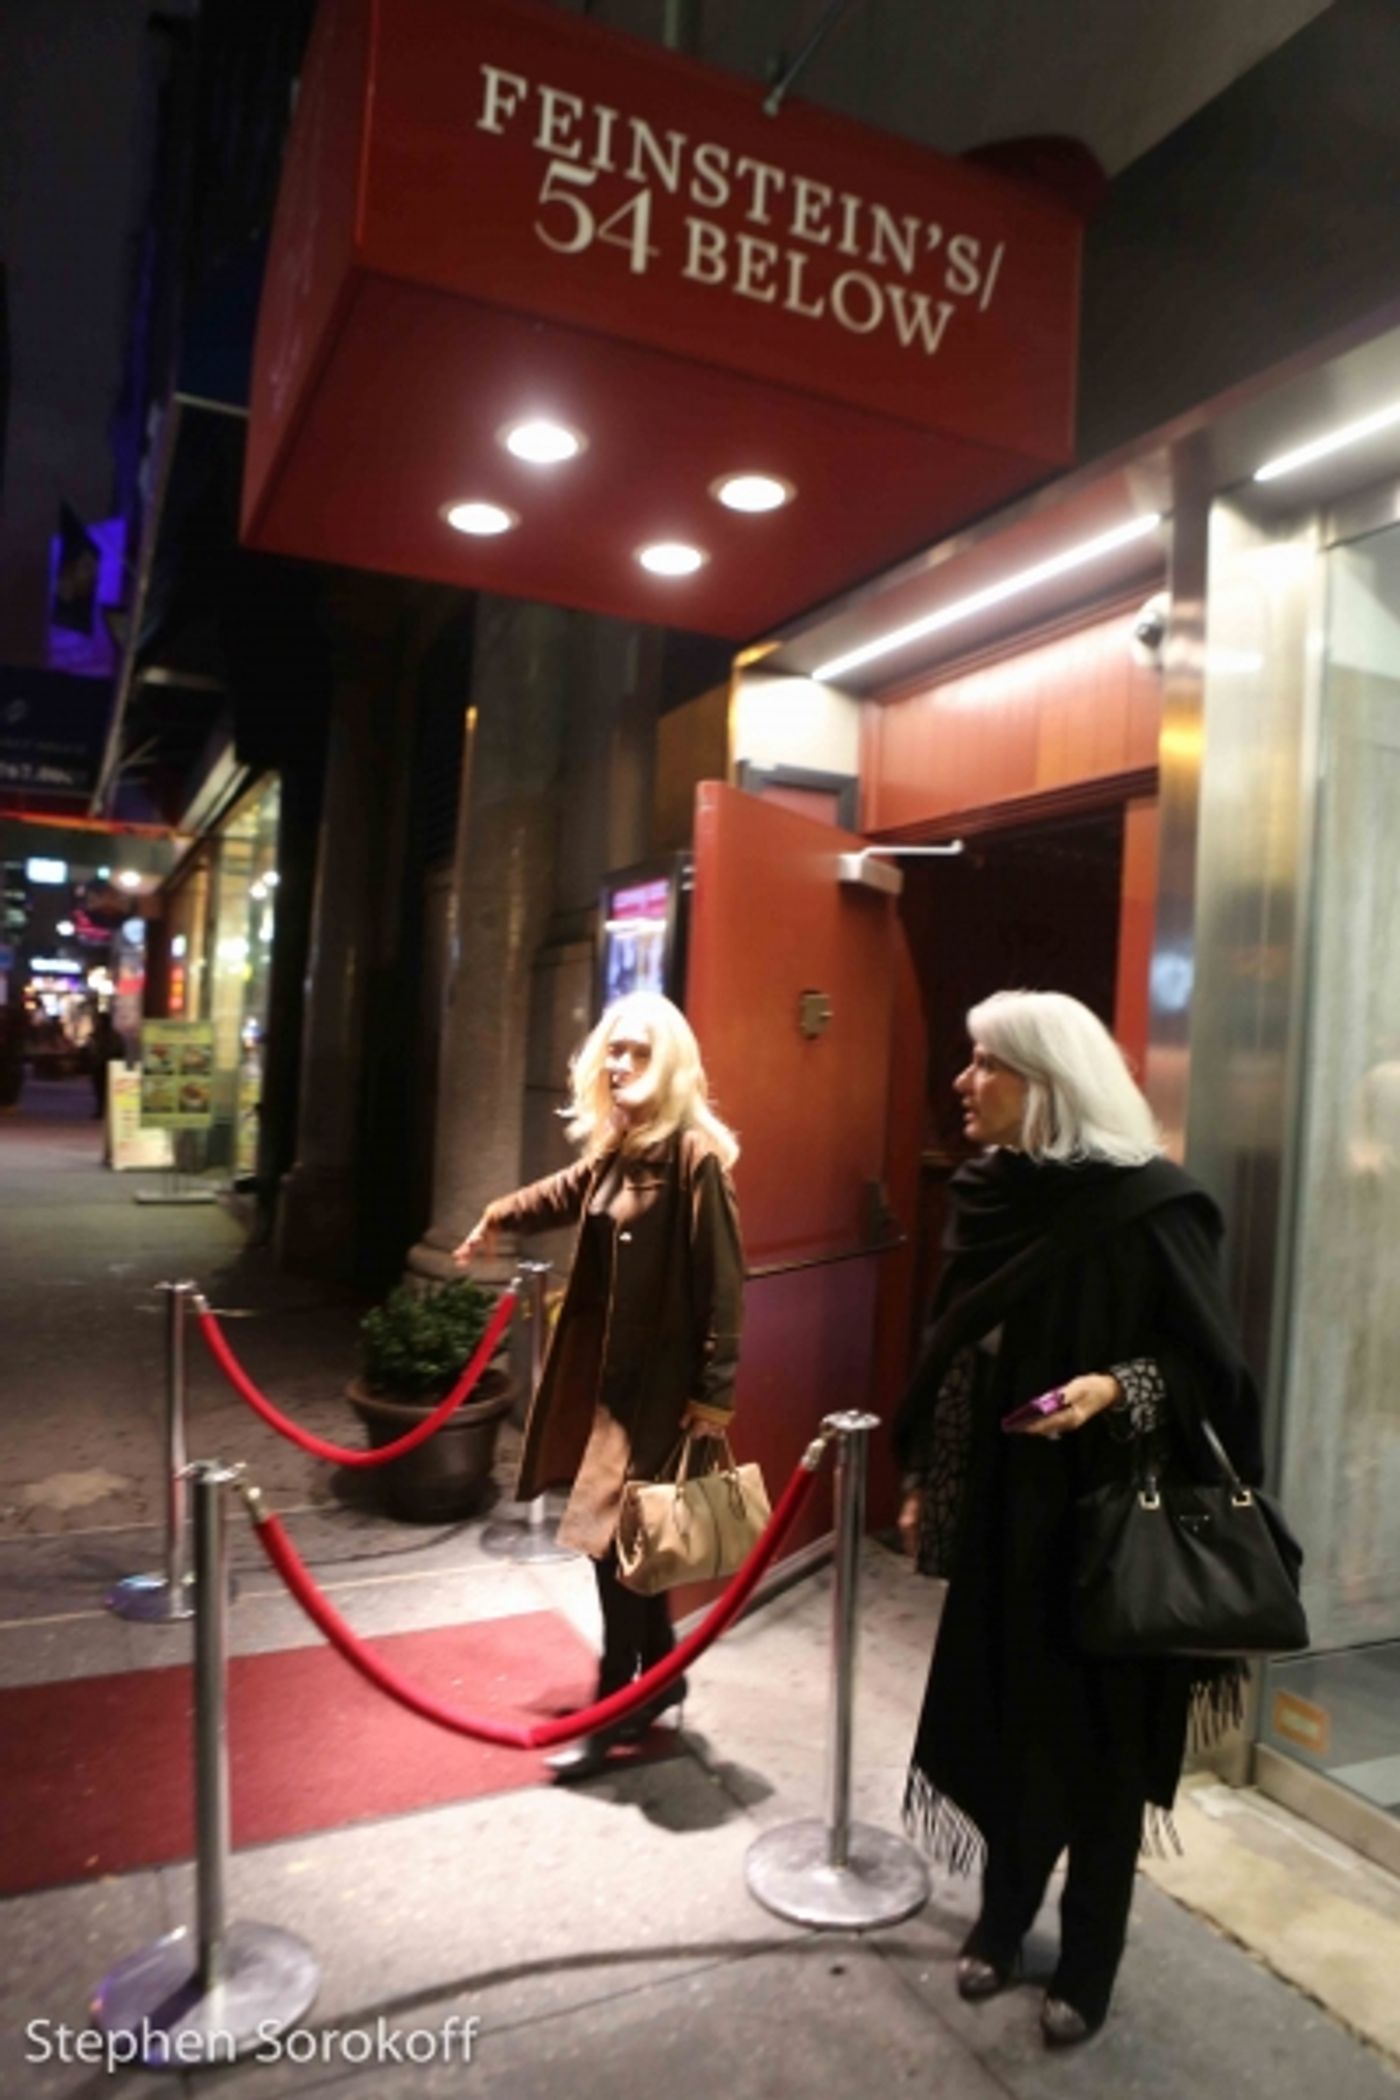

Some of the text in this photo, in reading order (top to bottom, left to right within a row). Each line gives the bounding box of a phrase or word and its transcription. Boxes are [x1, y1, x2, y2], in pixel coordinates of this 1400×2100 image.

[476, 64, 1004, 312] FEINSTEIN'S/
[534, 160, 955, 355] 54 BELOW
